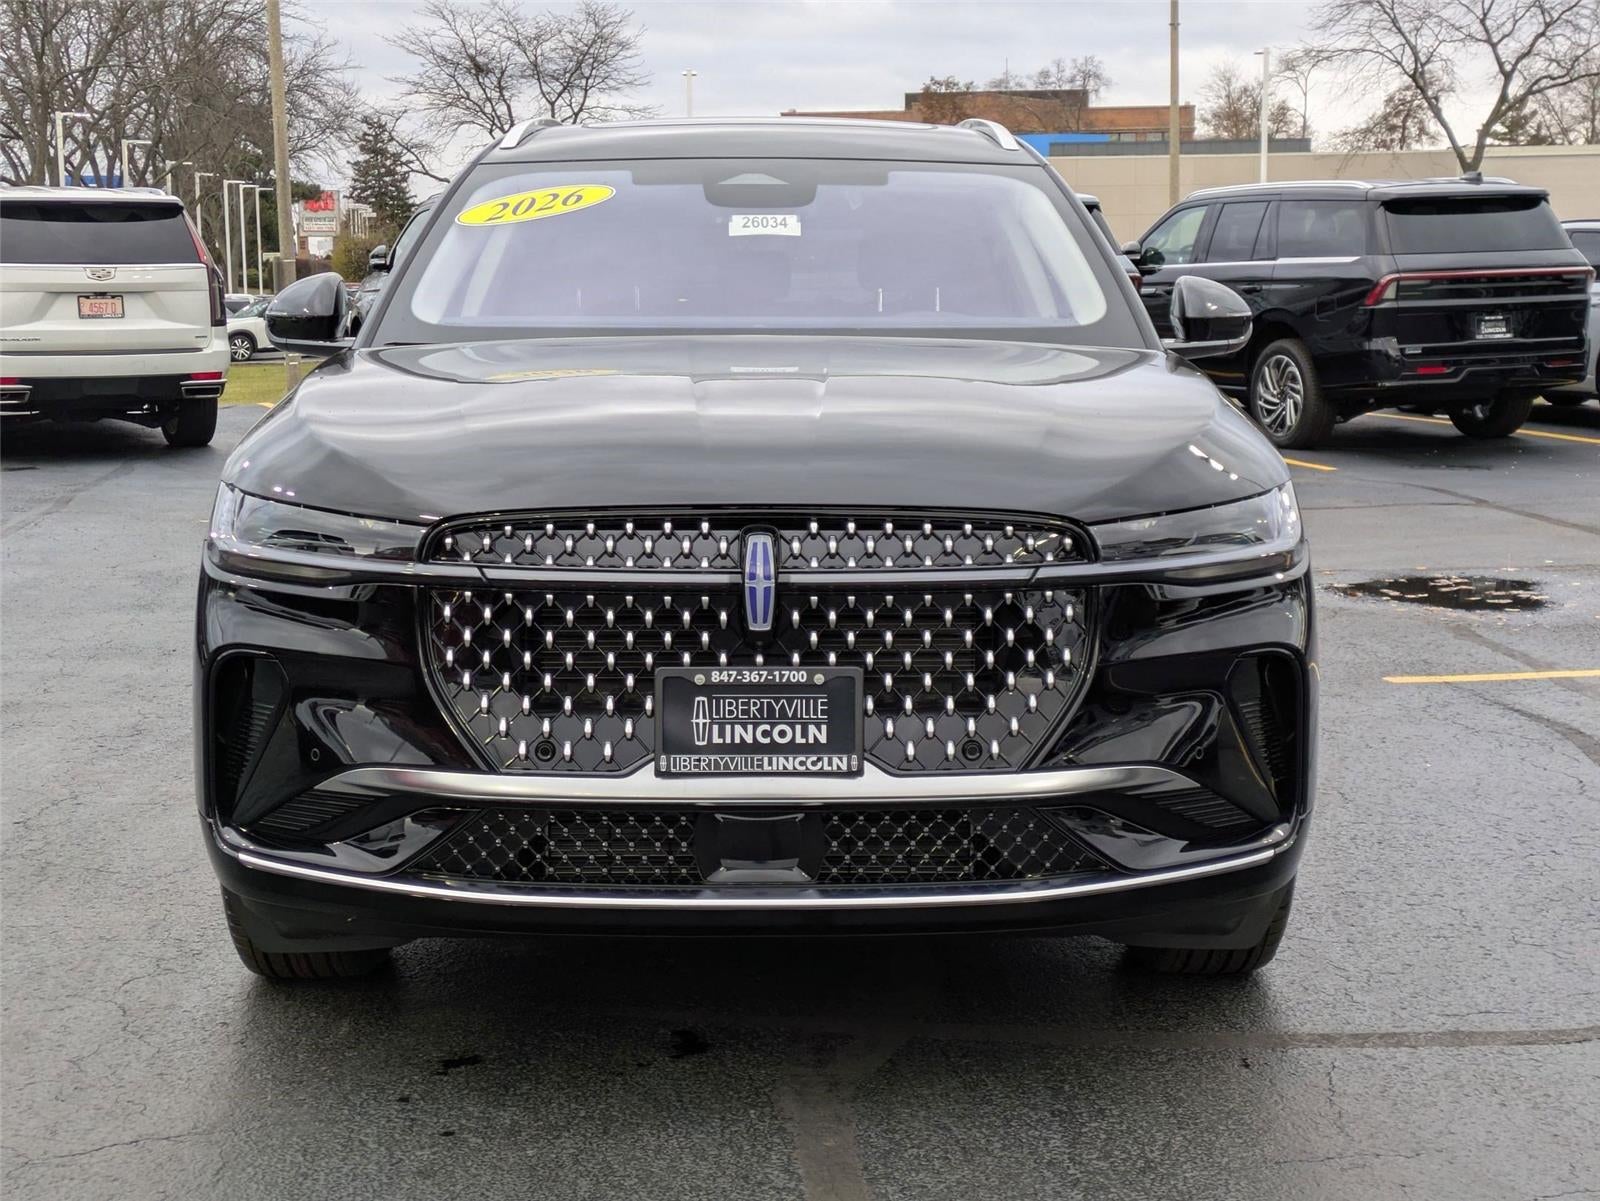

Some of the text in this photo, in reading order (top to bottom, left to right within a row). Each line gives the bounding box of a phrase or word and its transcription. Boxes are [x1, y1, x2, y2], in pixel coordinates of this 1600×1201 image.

[484, 188, 585, 222] 2026
[742, 216, 788, 228] 26034
[711, 671, 807, 683] 847-367-1700
[712, 699, 828, 719] LIBERTYVILLE
[712, 724, 828, 744] LINCOLN
